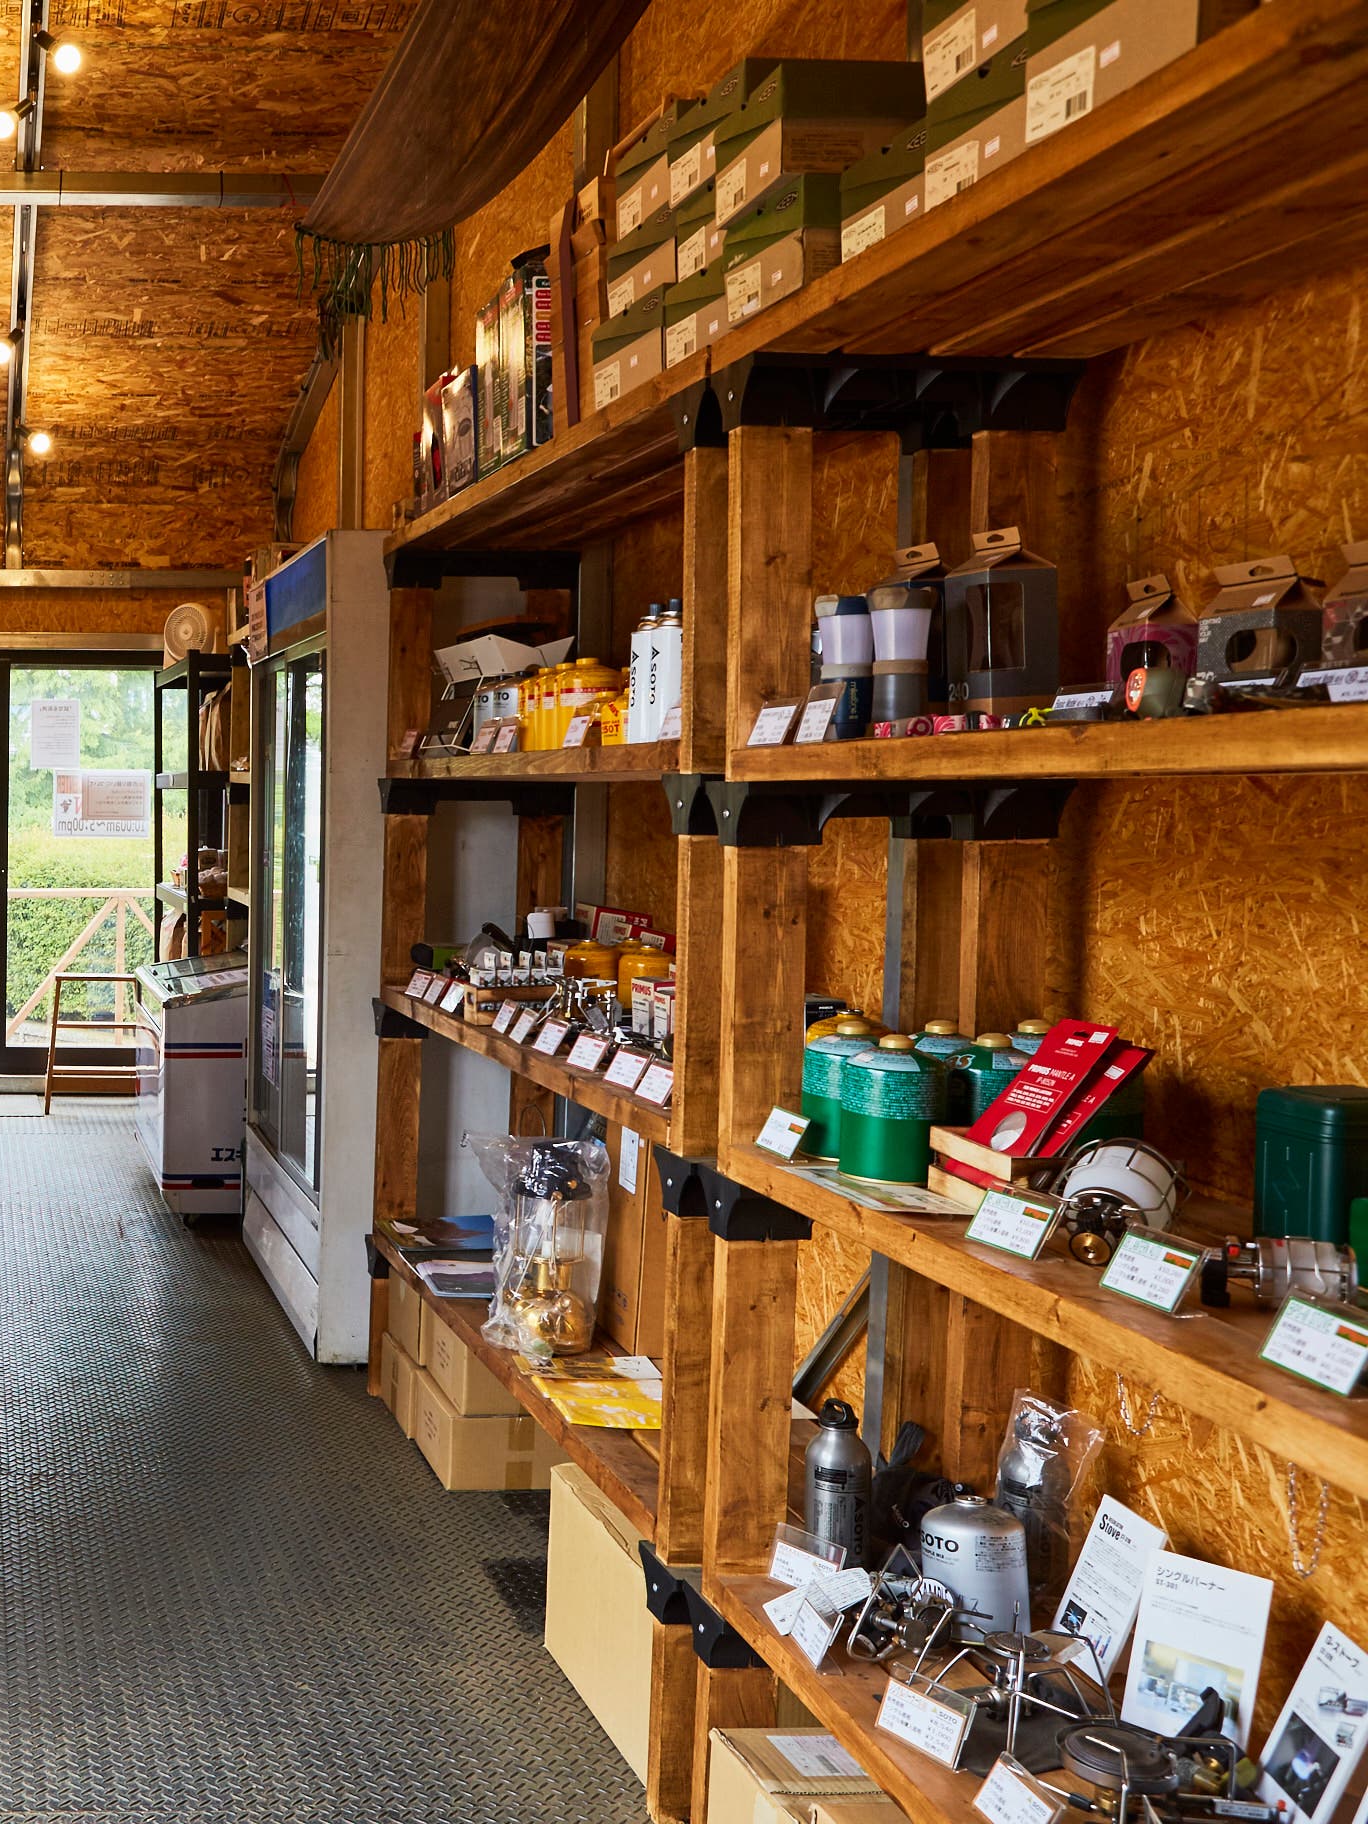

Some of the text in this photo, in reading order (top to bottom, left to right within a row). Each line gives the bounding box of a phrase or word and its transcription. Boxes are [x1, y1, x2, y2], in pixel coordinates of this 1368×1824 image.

[906, 129, 927, 150] KEE
[776, 191, 798, 211] KEEN
[948, 682, 969, 701] 240
[1049, 1068, 1070, 1080] MANTLE
[1070, 1073, 1076, 1081] A
[1099, 1514, 1121, 1540] Stove
[921, 1531, 959, 1552] SOTO
[1157, 1566, 1225, 1591] シングルバーナー
[939, 1711, 958, 1725] SOTO
